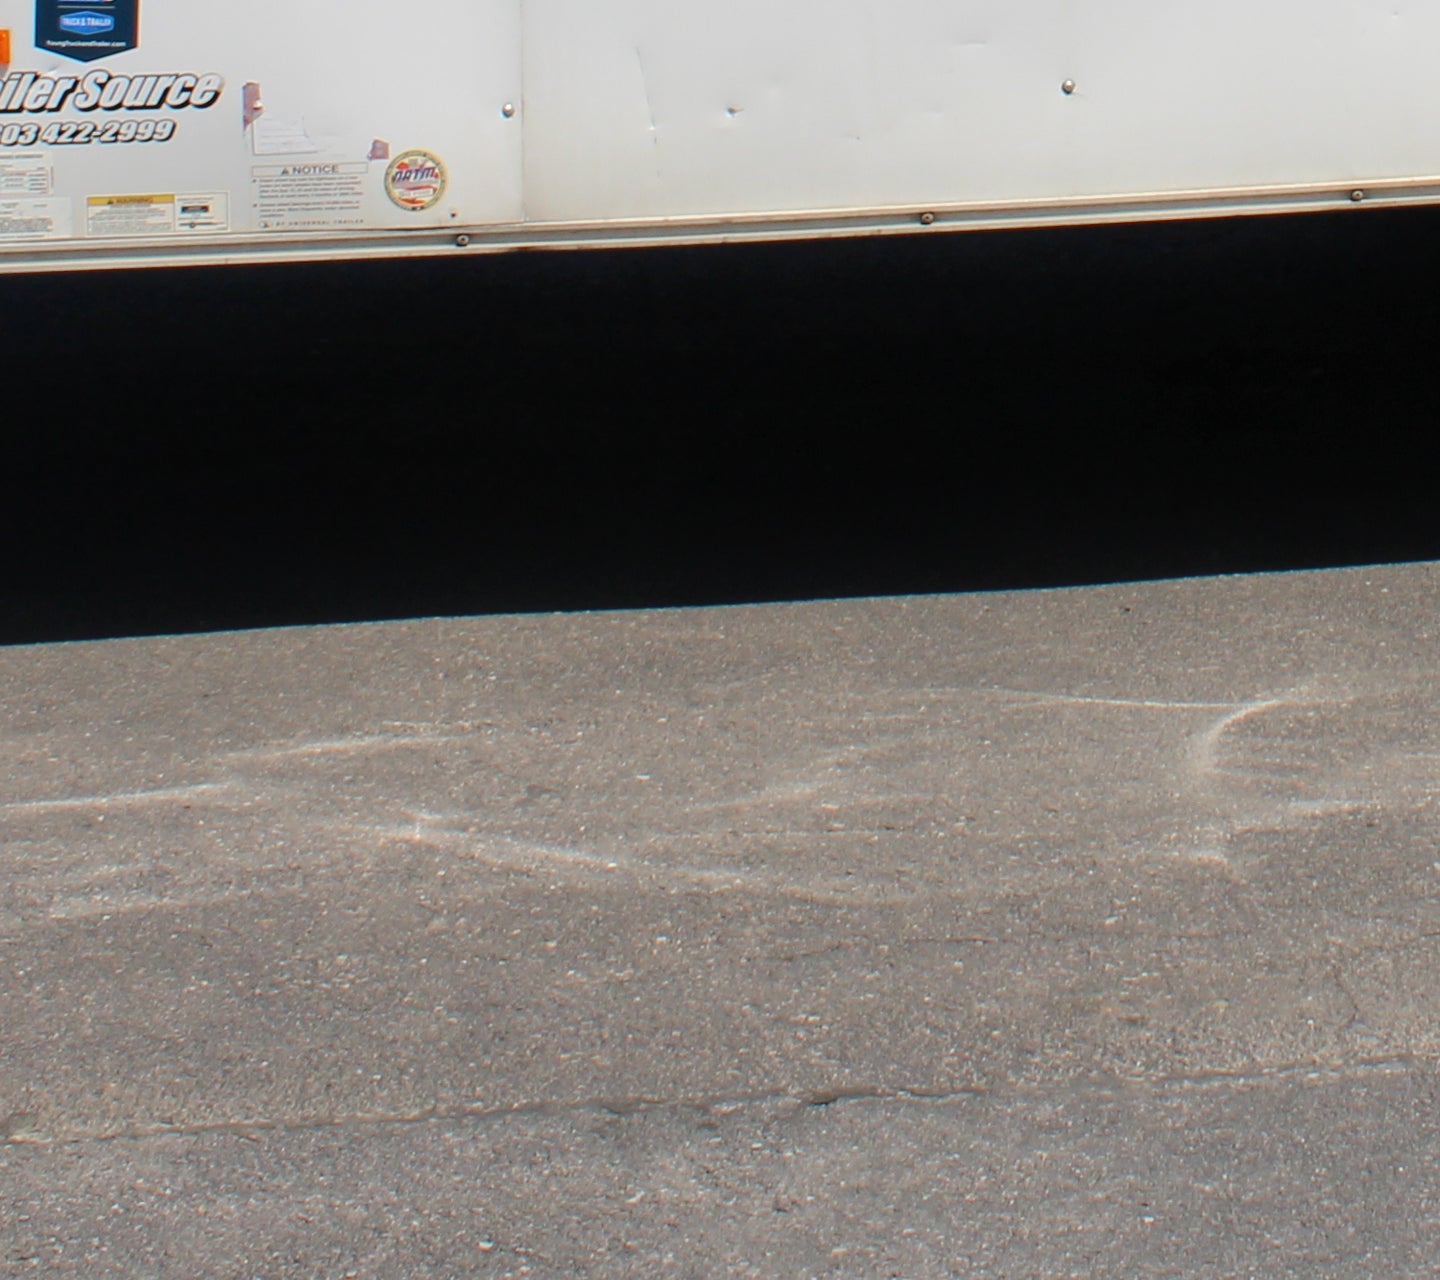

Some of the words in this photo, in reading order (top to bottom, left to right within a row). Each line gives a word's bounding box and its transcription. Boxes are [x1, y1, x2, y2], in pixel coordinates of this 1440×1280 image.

[74, 69, 224, 112] Source
[41, 119, 178, 146] 422-2999
[292, 165, 339, 175] NOTICE
